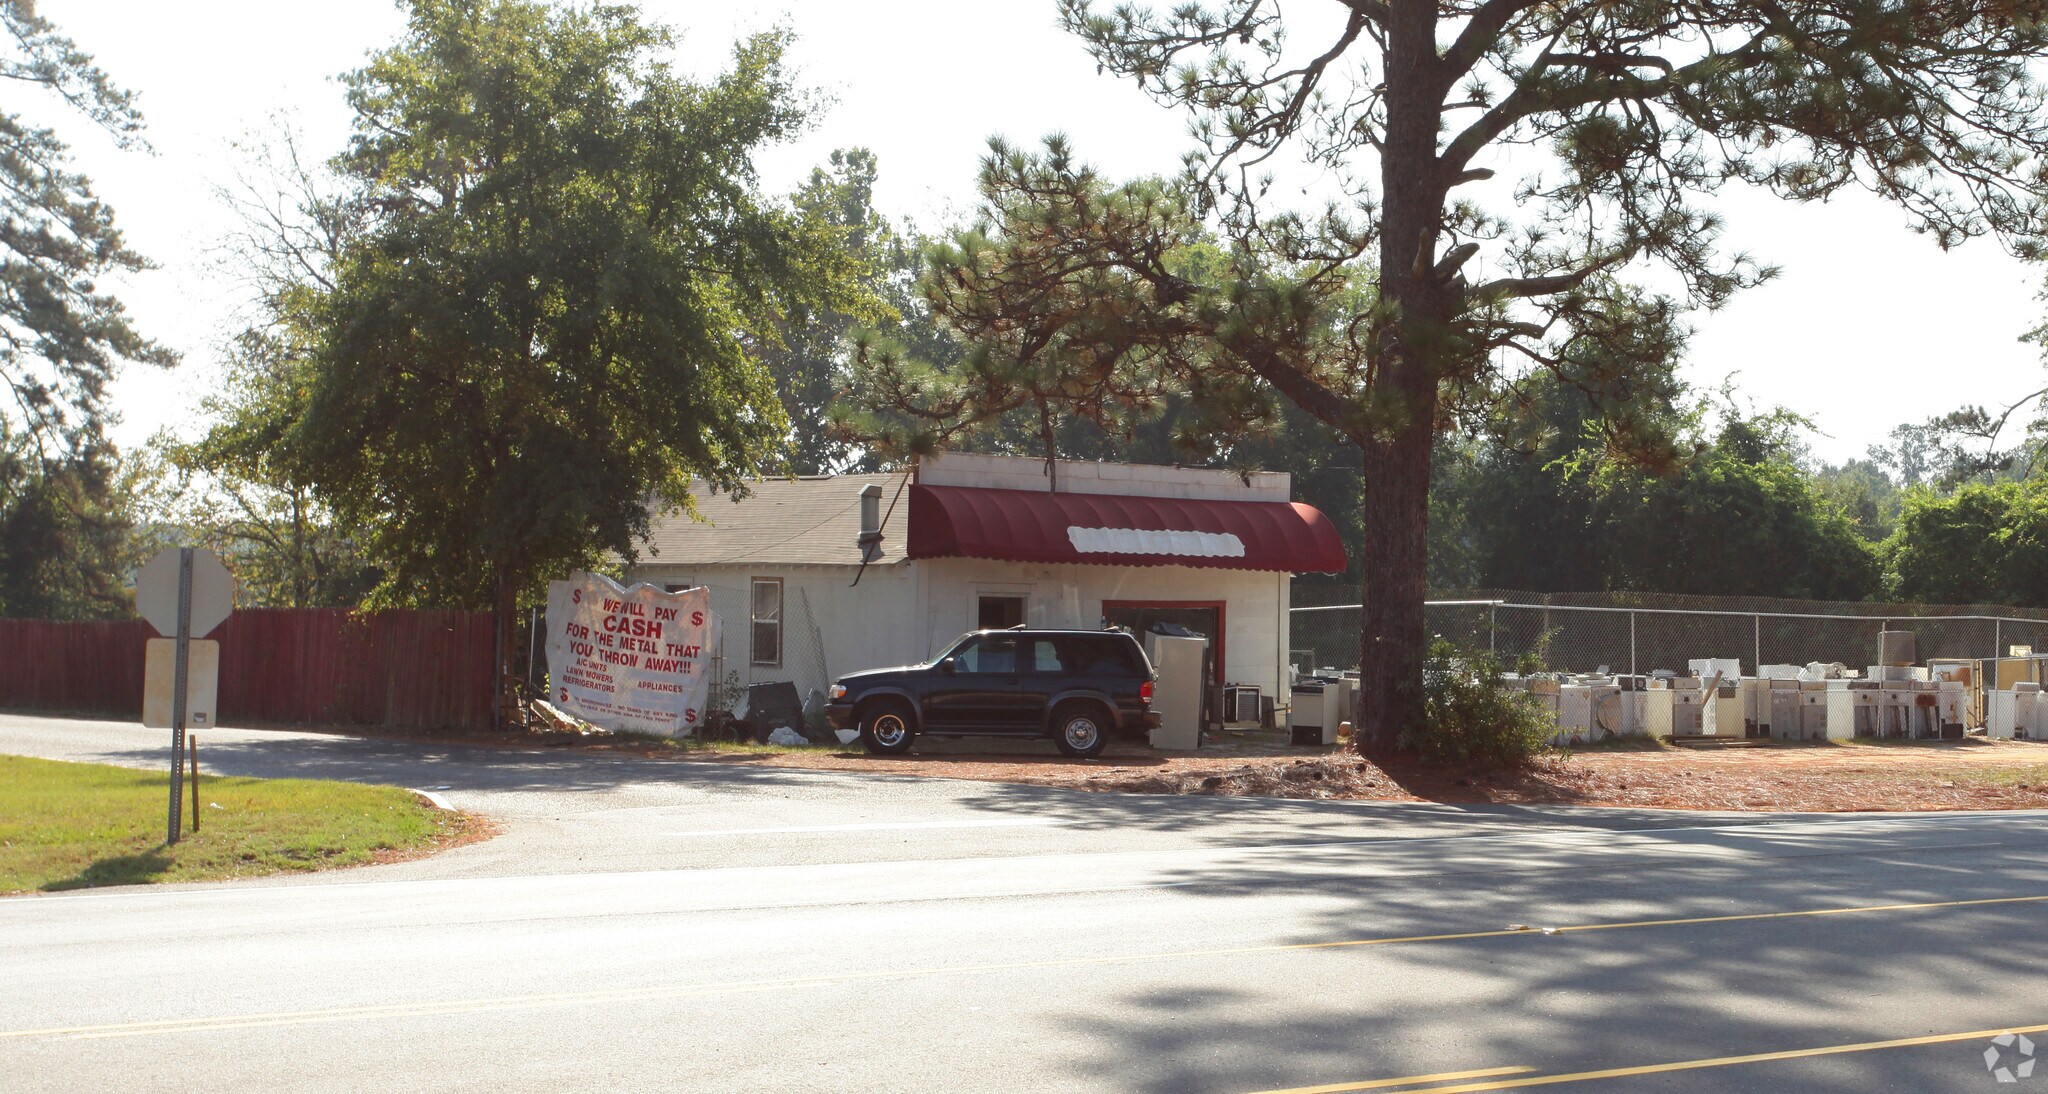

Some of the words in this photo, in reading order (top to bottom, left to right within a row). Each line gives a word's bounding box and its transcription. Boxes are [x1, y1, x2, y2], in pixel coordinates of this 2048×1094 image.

[603, 598, 620, 613] WE
[620, 602, 645, 617] WILL
[655, 607, 678, 621] PAY
[603, 615, 662, 639] CASH
[691, 611, 704, 627] $
[566, 622, 590, 640] FOR
[594, 631, 614, 647] THE
[619, 636, 658, 655] METAL
[666, 643, 701, 659] THAT
[570, 640, 594, 657] YOU
[599, 649, 639, 667] THROW
[645, 658, 691, 674] AWAY!!!
[589, 660, 607, 672] UNITS
[562, 675, 616, 693] REFRIGERATORS
[566, 666, 584, 677] LAWN
[586, 670, 614, 684] MOWERS
[637, 681, 683, 693] APPLIANCES
[684, 708, 697, 724] $
